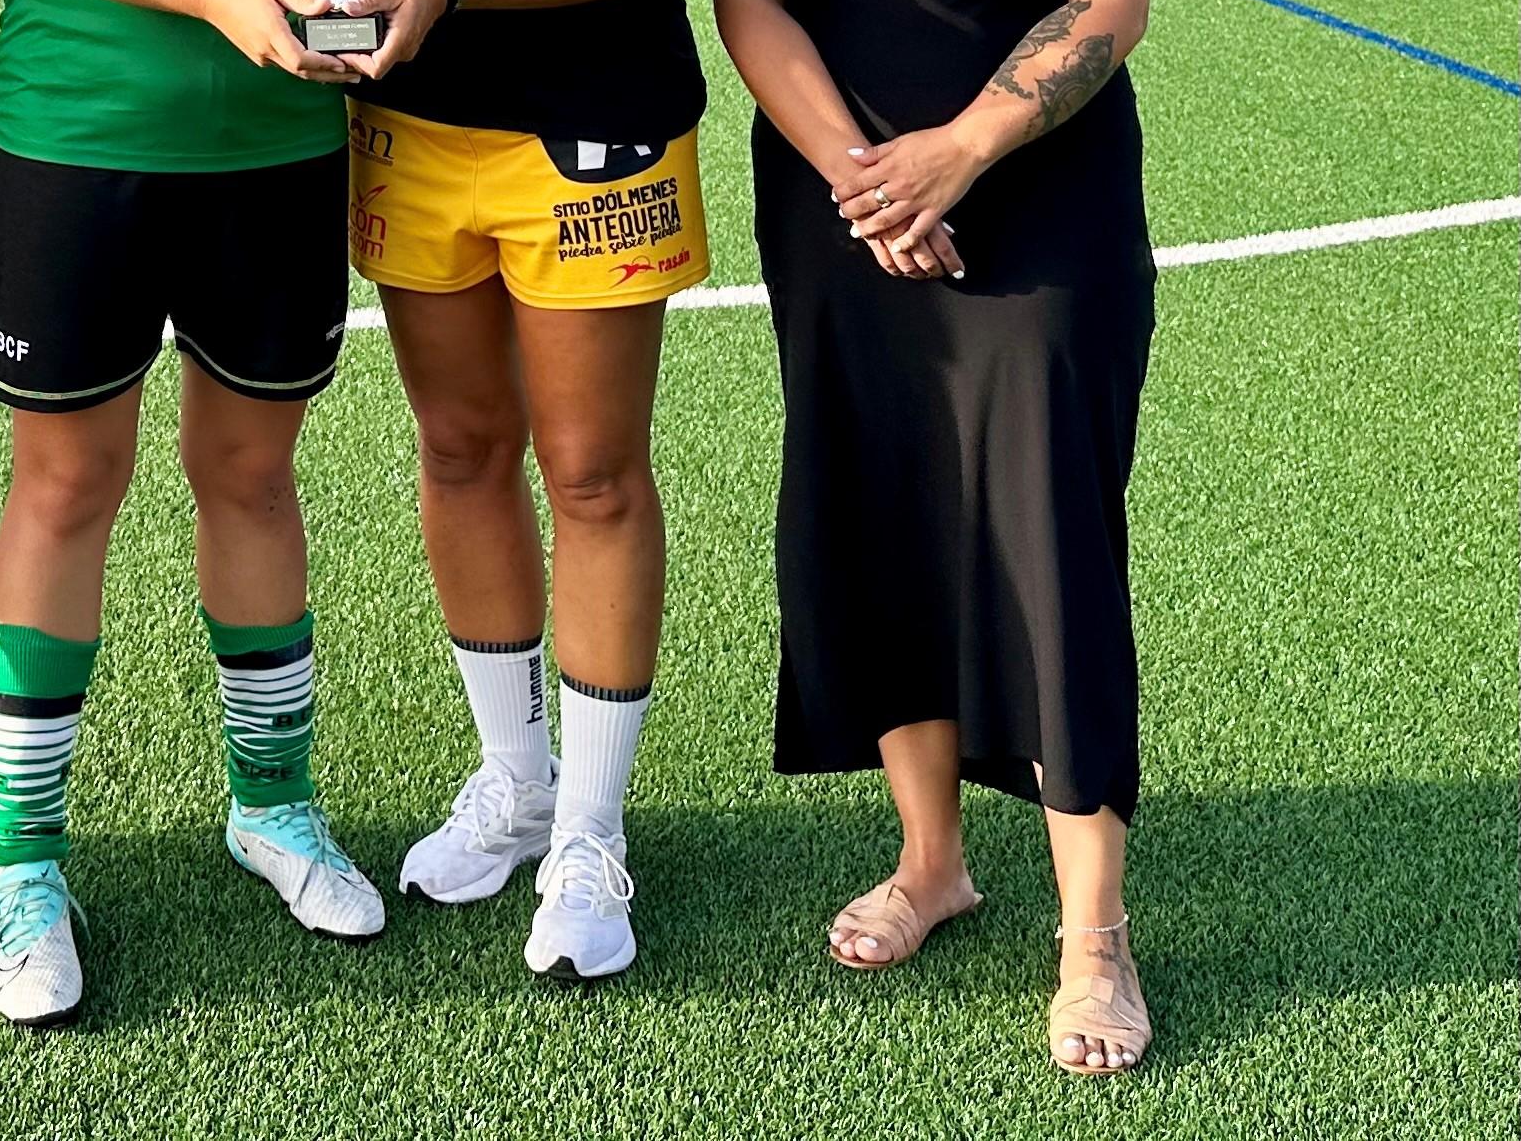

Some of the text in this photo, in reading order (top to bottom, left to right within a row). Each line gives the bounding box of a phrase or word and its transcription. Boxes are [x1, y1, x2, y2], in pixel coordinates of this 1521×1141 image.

[553, 177, 678, 218] SITIO DÓLMENES
[559, 198, 681, 245] ANTEQUERA
[558, 242, 605, 262] piedra
[609, 233, 647, 254] sobre
